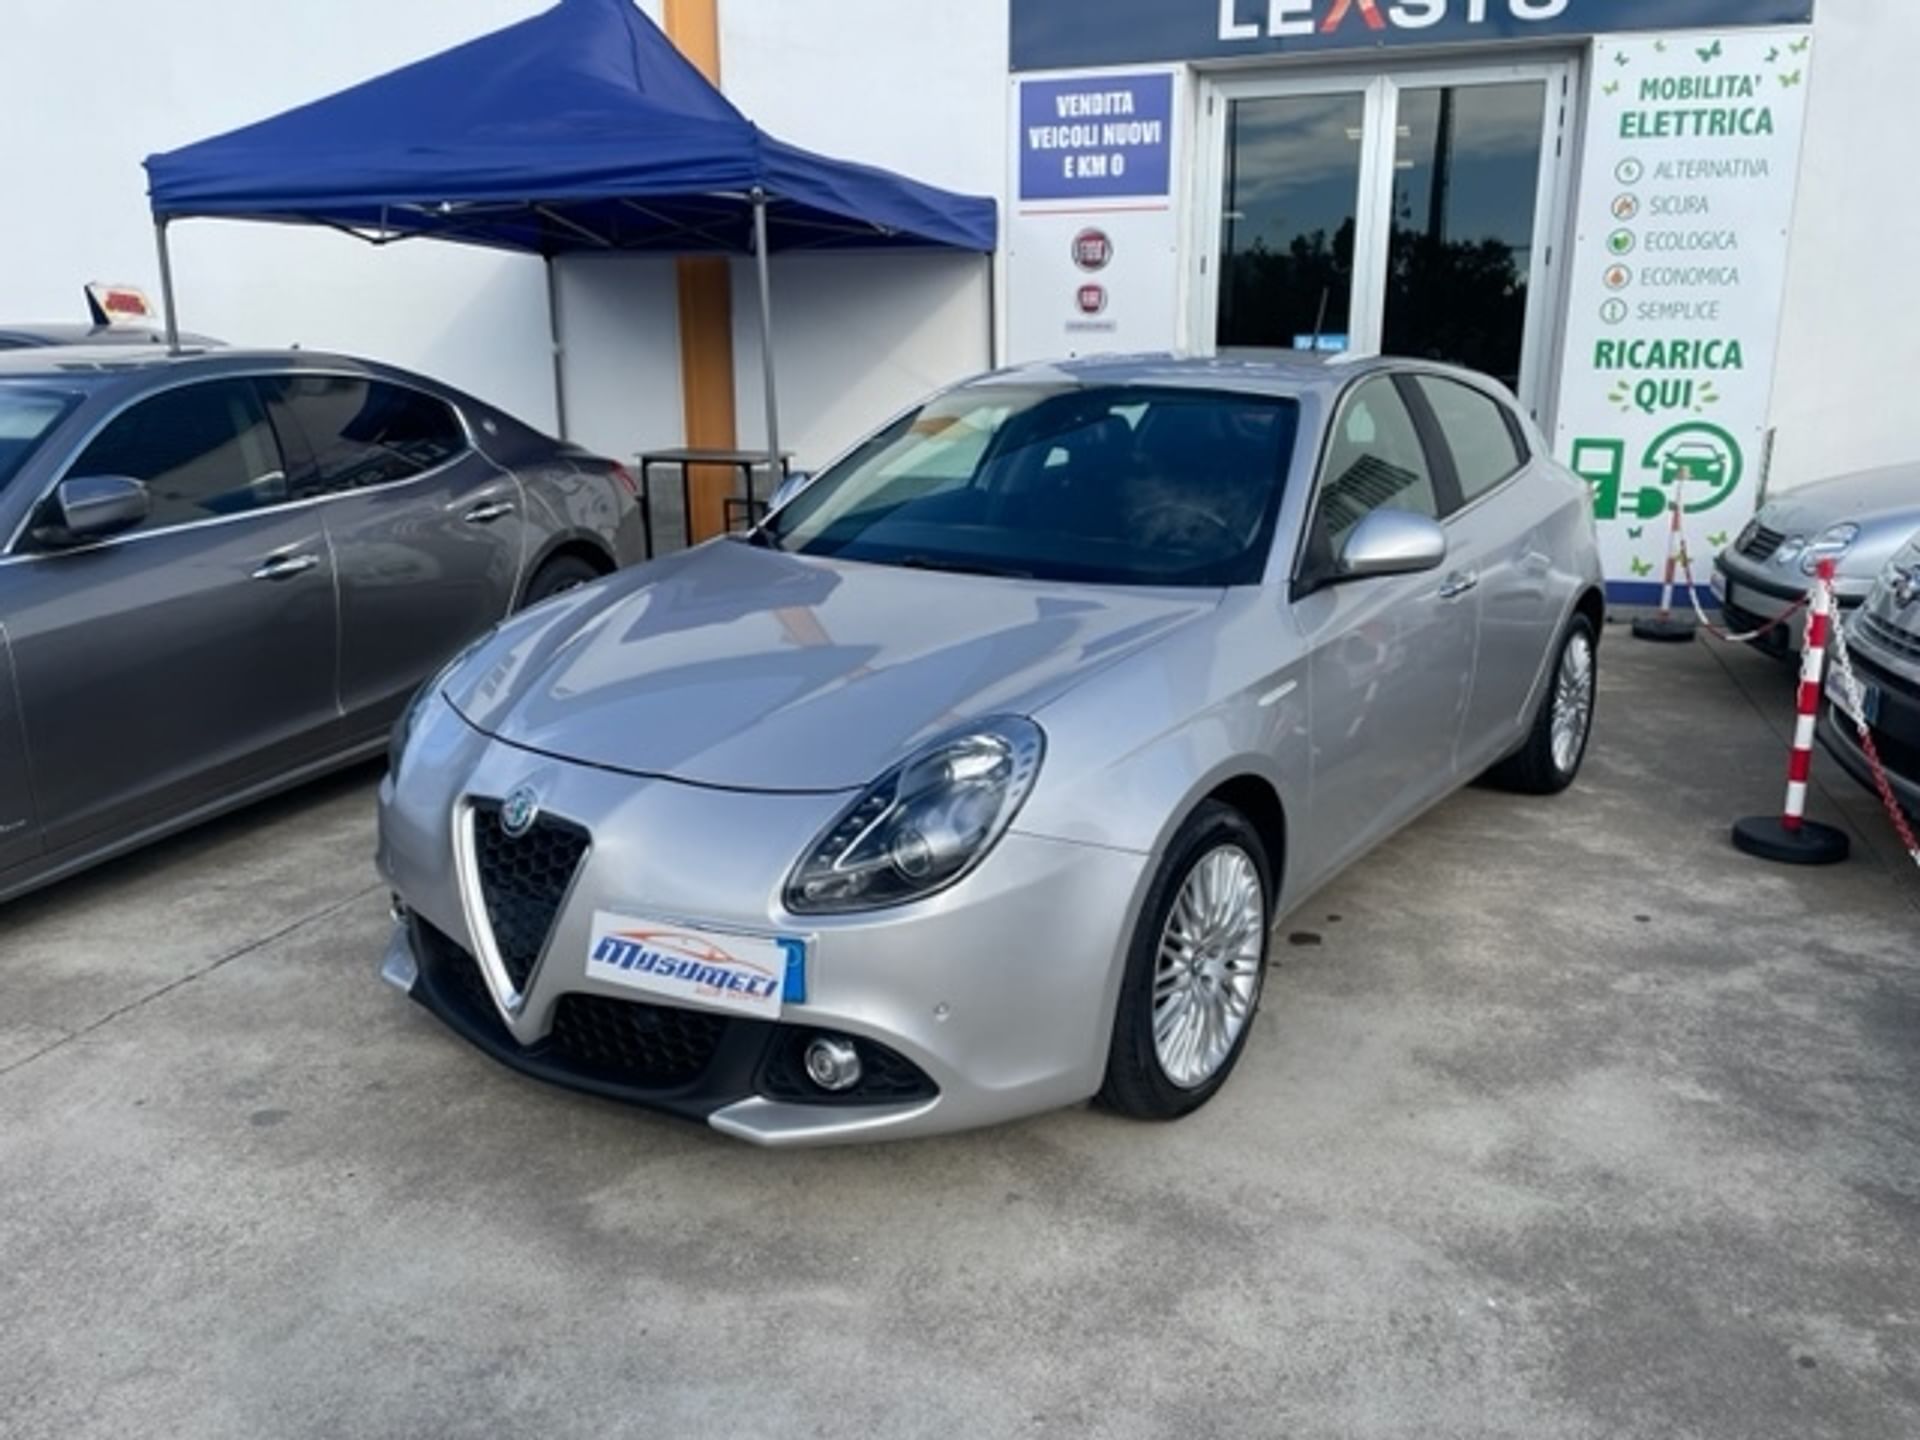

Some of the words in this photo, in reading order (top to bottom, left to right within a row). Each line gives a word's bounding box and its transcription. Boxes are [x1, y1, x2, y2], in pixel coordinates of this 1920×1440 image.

[1639, 75, 1762, 101] MOBILITA'
[1056, 90, 1134, 118] VENDITA
[1029, 124, 1099, 149] VEICOLI
[1103, 120, 1161, 146] NUOVI
[1619, 107, 1773, 139] ELETTRICA
[1064, 155, 1074, 178] E
[1077, 154, 1107, 177] KM
[1653, 158, 1769, 180] ALTERNATIVA
[1649, 195, 1710, 216] SICURA
[1644, 230, 1738, 252] ECOLOGICA
[1639, 266, 1740, 287] ECONOMICA
[1636, 301, 1720, 321] SEMPLICE
[1593, 339, 1743, 370] RICARICA
[1634, 378, 1693, 414] QUI
